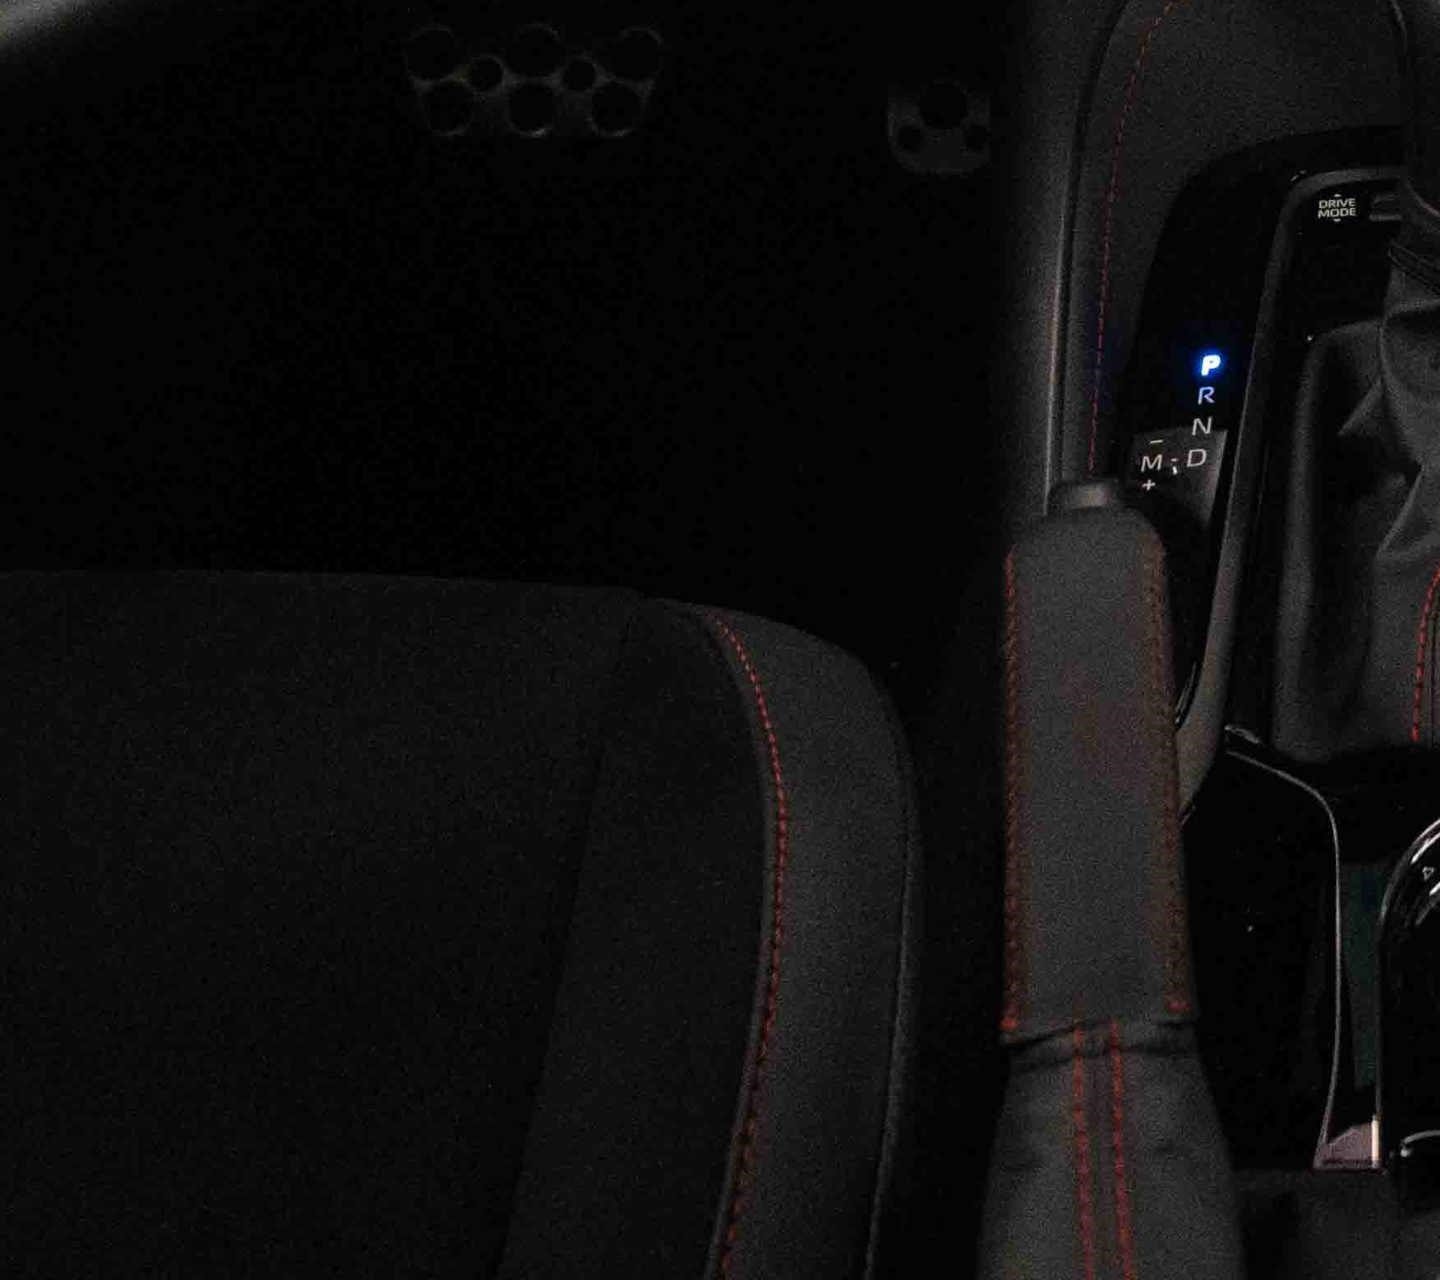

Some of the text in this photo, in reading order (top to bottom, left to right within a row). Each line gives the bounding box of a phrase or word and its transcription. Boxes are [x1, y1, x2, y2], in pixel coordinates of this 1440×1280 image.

[1317, 208, 1358, 219] MODE
[1318, 198, 1358, 209] DRIVE
[1200, 354, 1222, 376] P
[1197, 385, 1215, 405] R
[1191, 416, 1213, 436] N
[1140, 448, 1208, 473] M D
